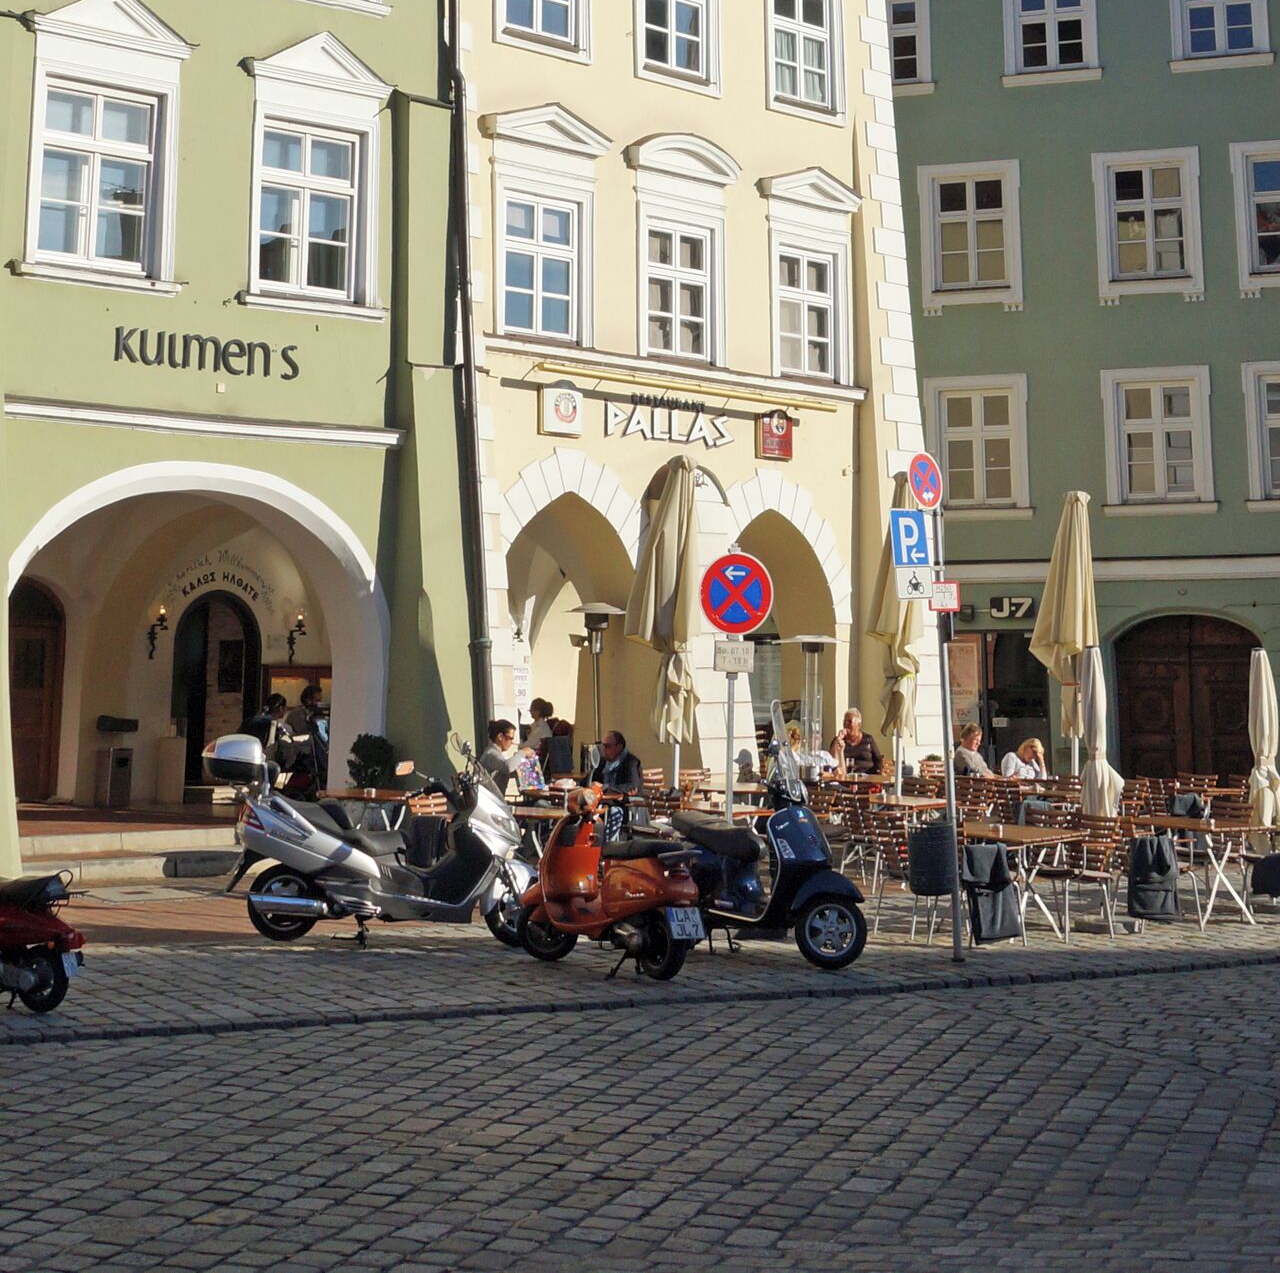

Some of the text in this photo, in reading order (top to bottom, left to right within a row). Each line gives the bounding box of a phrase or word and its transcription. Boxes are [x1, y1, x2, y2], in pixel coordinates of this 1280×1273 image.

[604, 398, 736, 450] PALLAS
[899, 517, 919, 563] P
[675, 910, 691, 922] LA
